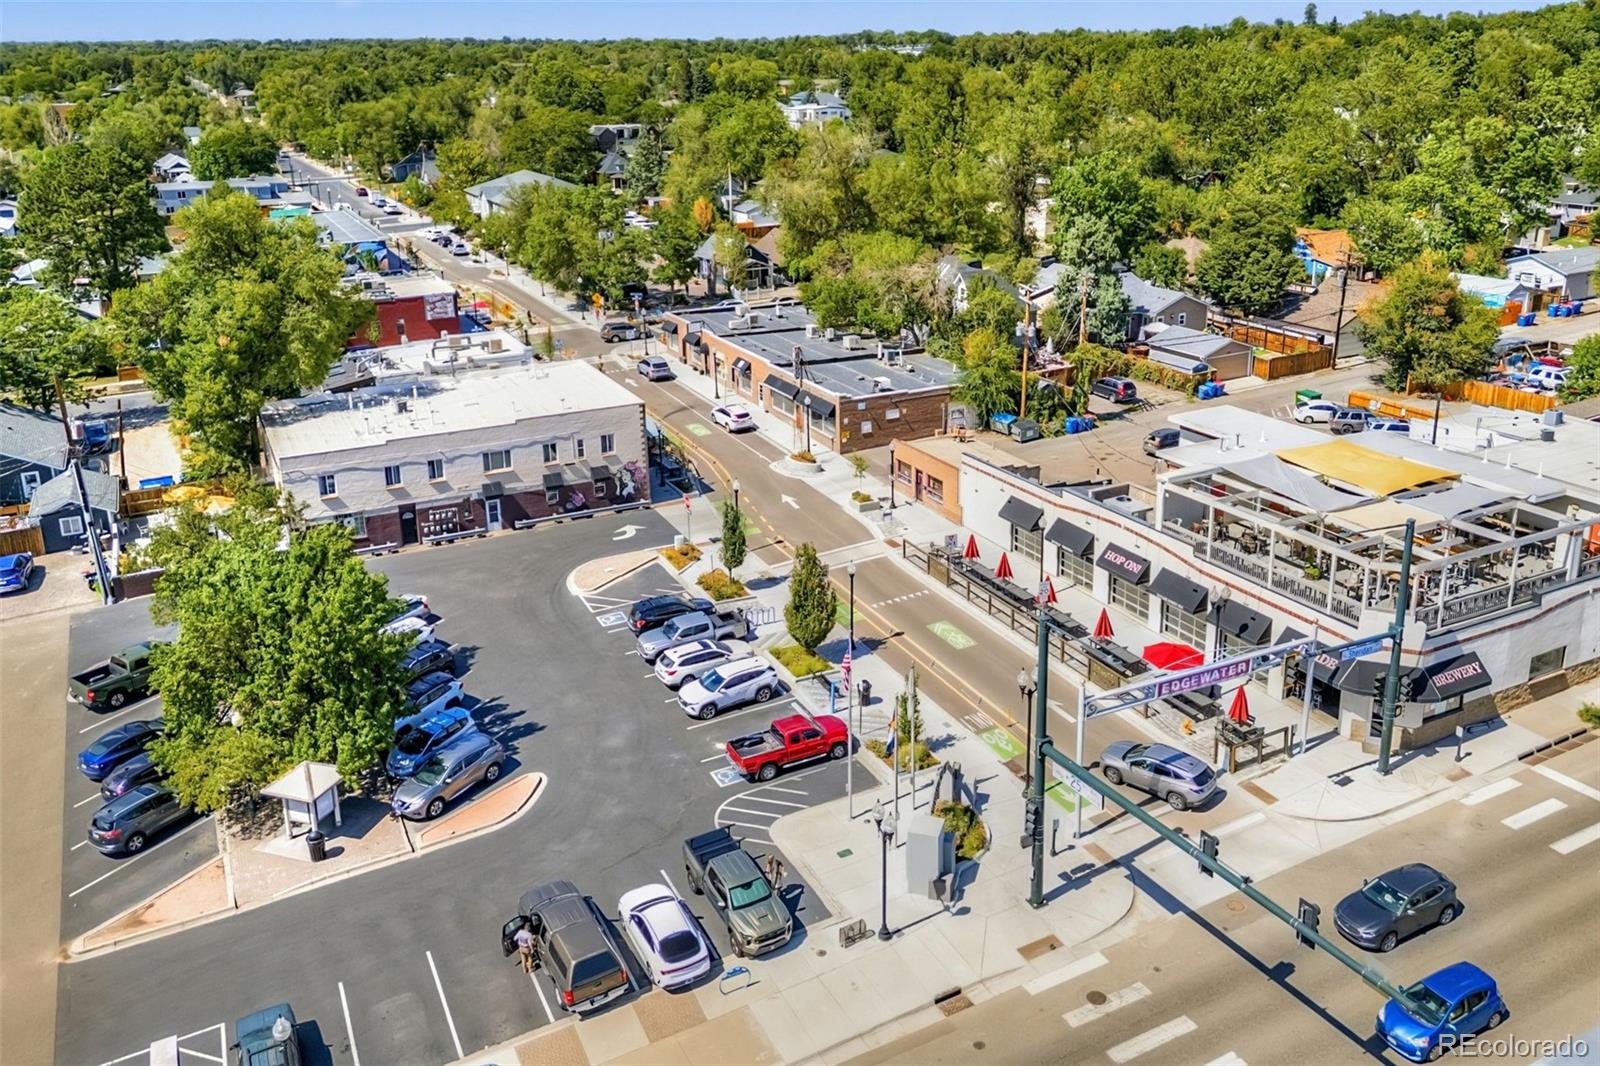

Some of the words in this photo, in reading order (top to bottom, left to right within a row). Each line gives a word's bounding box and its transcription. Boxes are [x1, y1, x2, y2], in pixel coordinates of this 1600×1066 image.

[1104, 550, 1127, 565] HOP
[1161, 662, 1247, 695] EDGEWATER
[1433, 661, 1483, 687] BREWERY
